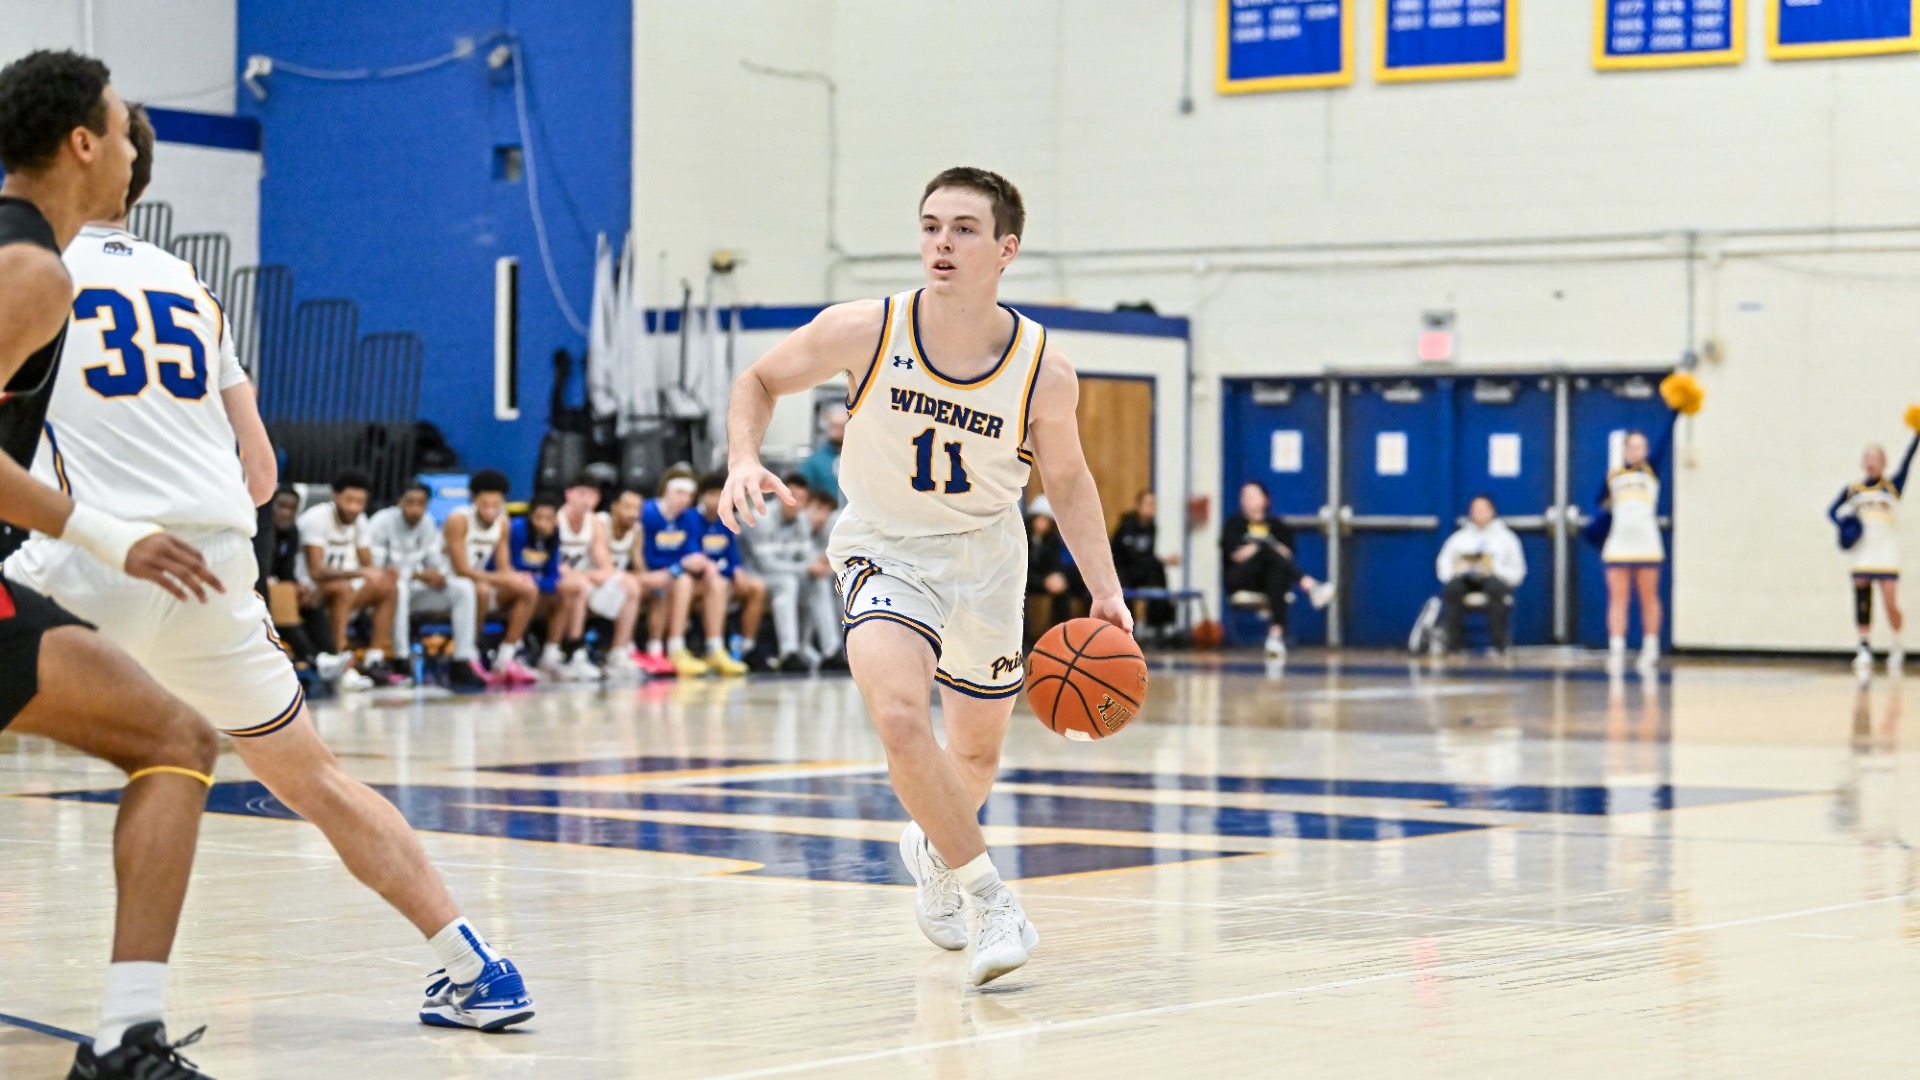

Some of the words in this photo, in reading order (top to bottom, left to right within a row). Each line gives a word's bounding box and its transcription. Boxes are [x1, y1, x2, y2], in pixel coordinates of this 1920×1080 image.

[71, 287, 208, 400] 35
[890, 387, 1004, 439] WIDENER
[911, 426, 972, 494] 11
